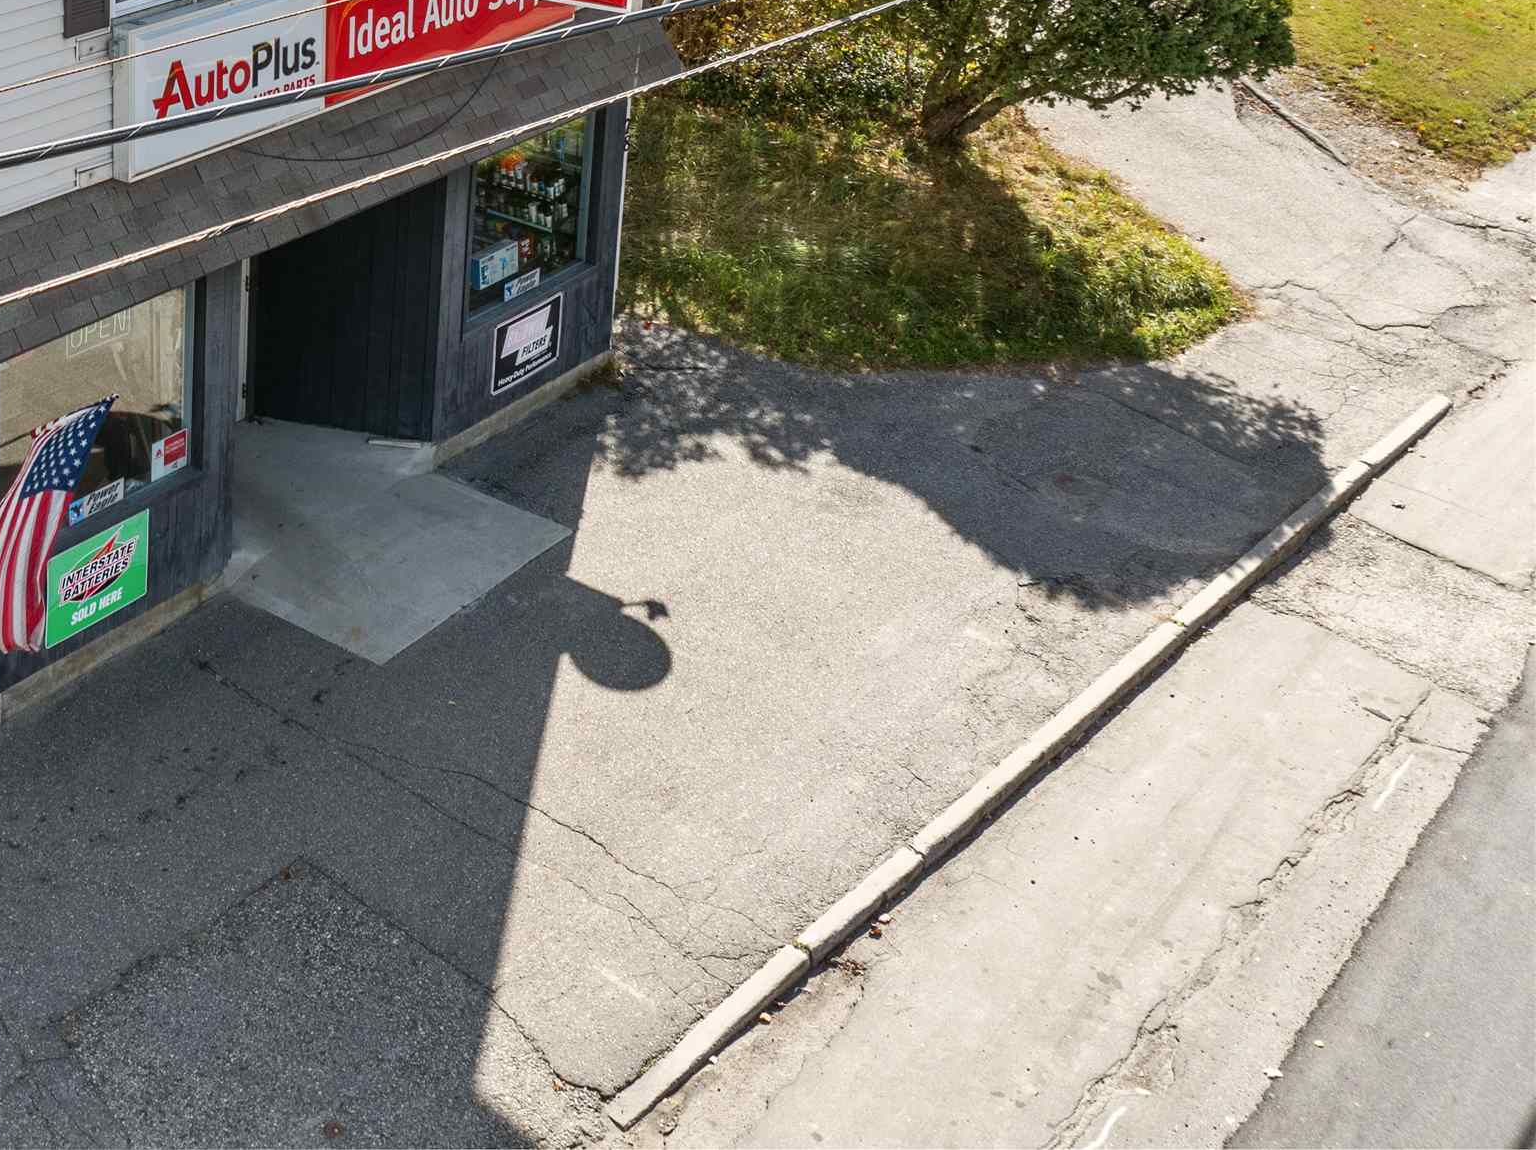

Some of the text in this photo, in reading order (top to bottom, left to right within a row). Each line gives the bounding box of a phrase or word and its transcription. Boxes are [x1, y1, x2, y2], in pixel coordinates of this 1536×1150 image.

[152, 37, 316, 120] AutoPlus
[283, 74, 317, 94] PARTS
[521, 334, 547, 358] FILTERS
[61, 540, 136, 591] INTERSTATE
[63, 556, 130, 602] BATTERIES
[70, 587, 124, 626] SOLD HERE
